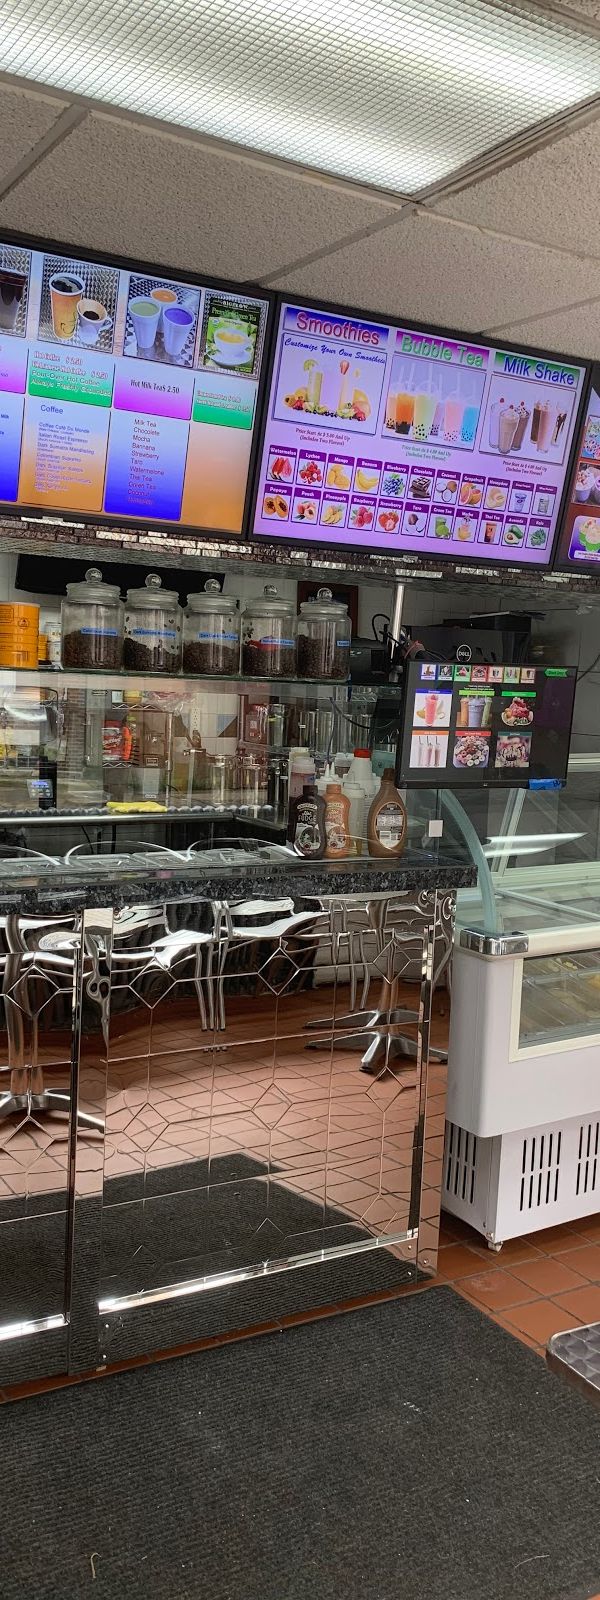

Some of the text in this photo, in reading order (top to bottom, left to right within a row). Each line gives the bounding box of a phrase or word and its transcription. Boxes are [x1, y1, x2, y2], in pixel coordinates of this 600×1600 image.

[296, 312, 380, 345] Smoothies
[284, 338, 318, 351] Customize
[320, 345, 336, 354] Your
[338, 348, 352, 358] Own
[401, 335, 484, 368] Bubble Tea
[504, 356, 574, 386] Milk Shake
[130, 380, 140, 388] Hot
[141, 381, 152, 390] Milk
[166, 386, 180, 394] 2.50
[40, 404, 64, 414] Coffee
[134, 418, 145, 426] Milk
[134, 426, 160, 436] Chocolate
[133, 434, 150, 442] Mocha
[270, 447, 296, 456] Watermelon
[306, 452, 320, 460] Lychee
[386, 464, 406, 472] Blueberry
